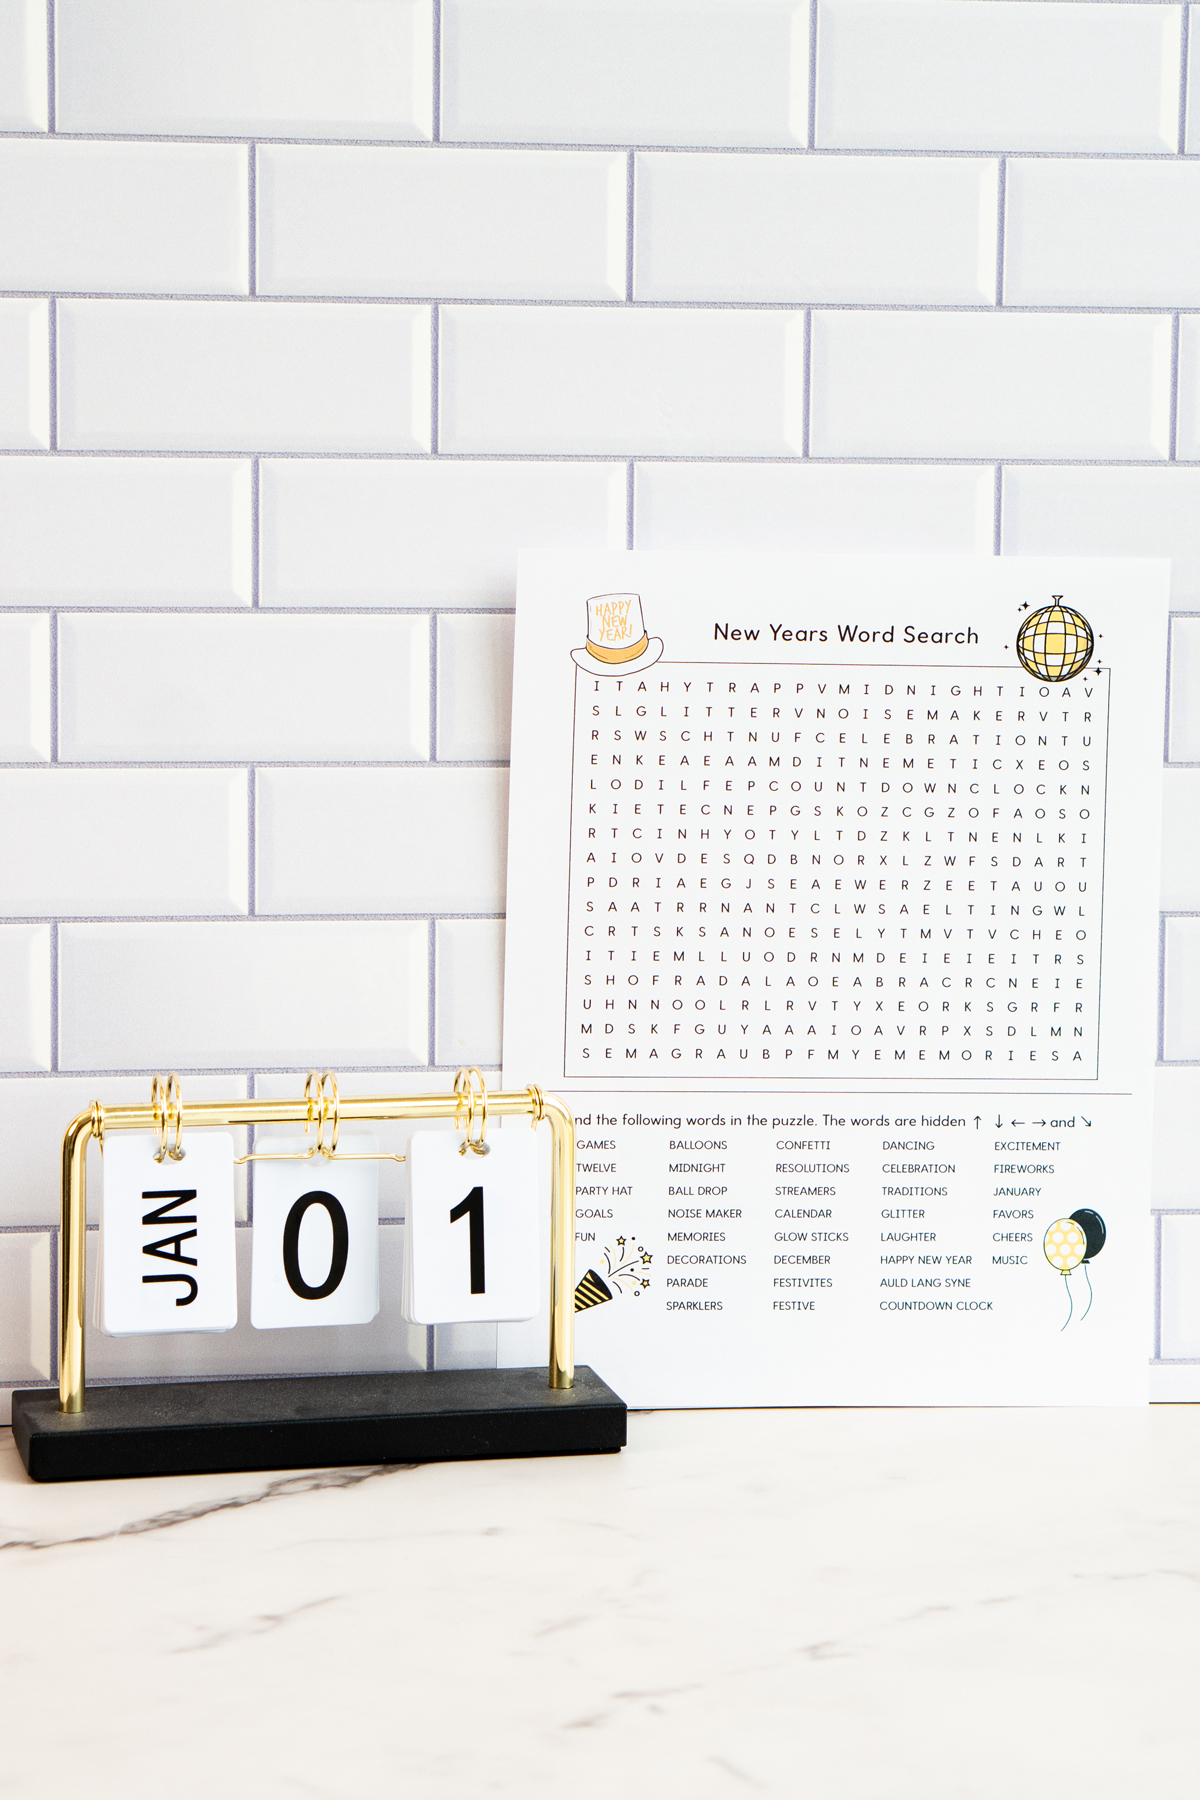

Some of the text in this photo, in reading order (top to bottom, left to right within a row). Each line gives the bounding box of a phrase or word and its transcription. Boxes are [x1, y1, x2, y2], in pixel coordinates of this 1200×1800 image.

[596, 600, 631, 616] HAPPY
[602, 615, 628, 628] NEW
[599, 623, 633, 642] YEAR!
[714, 623, 978, 644] New Years Word Search
[594, 680, 1094, 698] I T A H Y T R A P P V M I D N I G H T I O A V
[586, 852, 1087, 868] A I O V D E S Q D B N O R X L Z W F S D A R T
[586, 950, 907, 964] I T I E M L L U O D R N M D E
[582, 1047, 1082, 1062] S E M A G R A U B P F M Y E M E M O R I E S A
[575, 1113, 592, 1126] nd
[597, 1114, 617, 1125] the
[623, 1114, 681, 1129] following
[686, 1114, 725, 1125] words
[730, 1114, 742, 1126] in
[747, 1114, 767, 1125] the
[773, 1114, 817, 1129] puzzle.
[823, 1114, 845, 1126] The
[851, 1115, 889, 1126] words
[922, 1115, 965, 1126] hidden
[1050, 1116, 1075, 1127] and
[577, 1140, 616, 1149] GAMES
[670, 1141, 727, 1149] BALLOONS
[776, 1141, 830, 1150] CONFETTI
[883, 1141, 935, 1150] DANCING
[995, 1142, 1060, 1151] EXCITEMENT
[576, 1163, 616, 1172] TWELVE
[669, 1164, 725, 1172] MIDNIGHT
[776, 1164, 849, 1173] RESOLUTIONS
[882, 1164, 955, 1173] CELEBRATION
[994, 1164, 1054, 1173] FIREWORKS
[576, 1186, 633, 1195] PARTY HAT
[669, 1186, 727, 1195] BALL DROP
[775, 1187, 836, 1195] STREAMERS
[882, 1187, 947, 1196] TRADITIONS
[994, 1188, 1041, 1196] JANUARY
[575, 1209, 613, 1218] GOALS
[668, 1209, 742, 1218] NOISE MAKER
[775, 1209, 832, 1218] CALENDAR
[881, 1209, 925, 1218] GLITTER
[993, 1210, 1034, 1219] FAVORS
[450, 1187, 485, 1294] 1
[575, 1232, 595, 1241] FUN
[668, 1232, 725, 1241] MEMORIES
[774, 1232, 849, 1241] GLOW STICKS
[881, 1233, 936, 1241] LAUGHTER
[993, 1233, 1033, 1242] CHEERS
[142, 1190, 198, 1306] JAN
[667, 1255, 746, 1264] DECORATIONS
[774, 1255, 830, 1264] DECEMBER
[881, 1256, 972, 1264] HAPPY NEW YEAR
[992, 1256, 1027, 1264] MUSIC
[667, 1278, 708, 1287] PARADE
[774, 1278, 832, 1287] FESTIVITES
[880, 1278, 970, 1287] AULD LANG SYNE
[666, 1301, 723, 1310] SPARKLERS
[773, 1301, 815, 1310] FESTIVE
[880, 1301, 993, 1310] COUNTDOWN CLOCK
